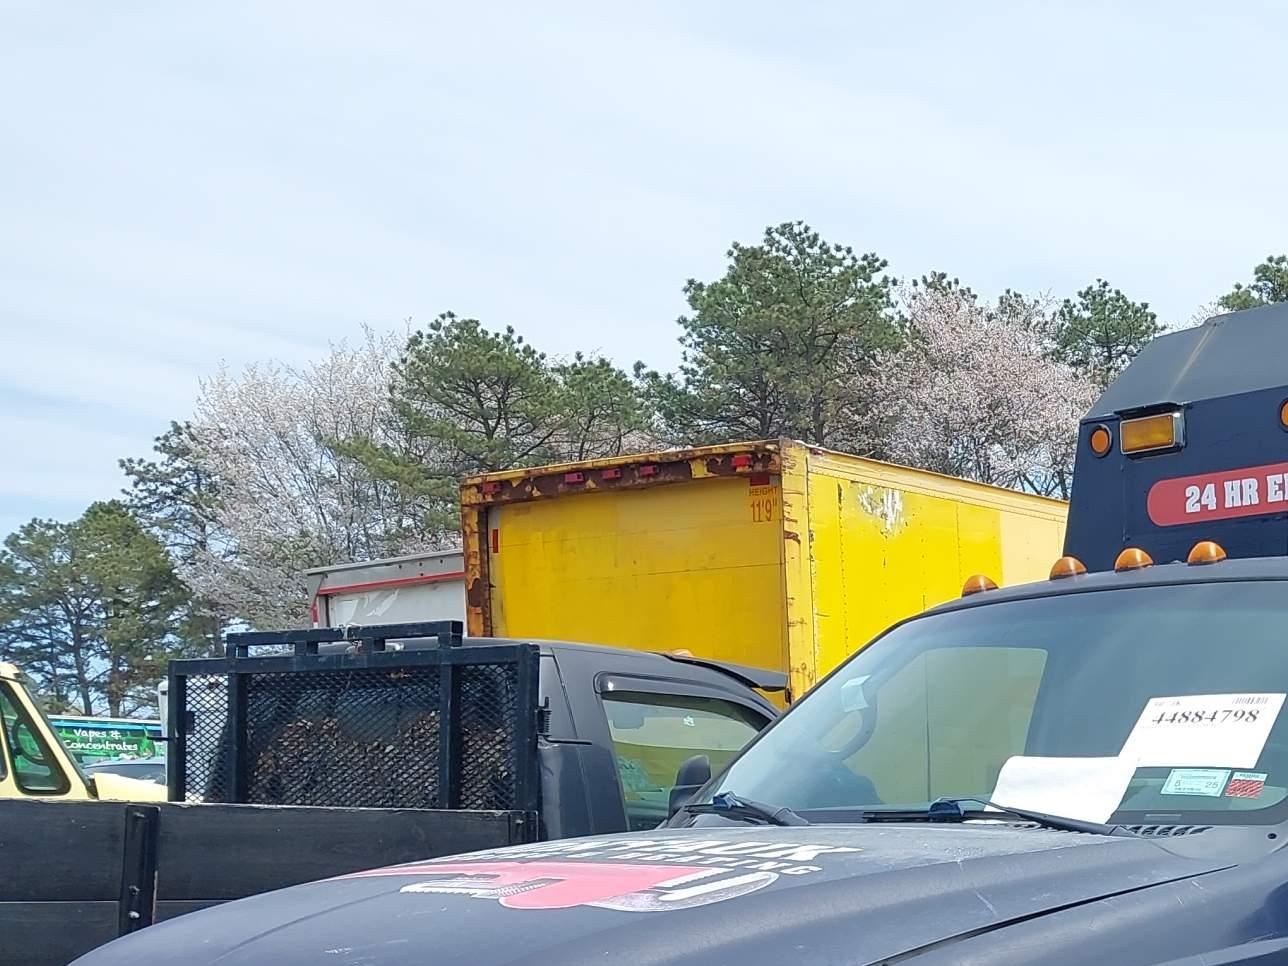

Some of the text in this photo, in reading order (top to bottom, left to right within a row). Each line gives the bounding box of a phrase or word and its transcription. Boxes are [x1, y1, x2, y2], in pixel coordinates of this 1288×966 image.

[749, 487, 778, 496] HEIGHT
[1184, 483, 1217, 513] 24
[1224, 477, 1259, 509] HR
[1152, 709, 1260, 725] 44884798
[73, 728, 122, 742] Vapes &
[63, 739, 138, 752] Concentrates
